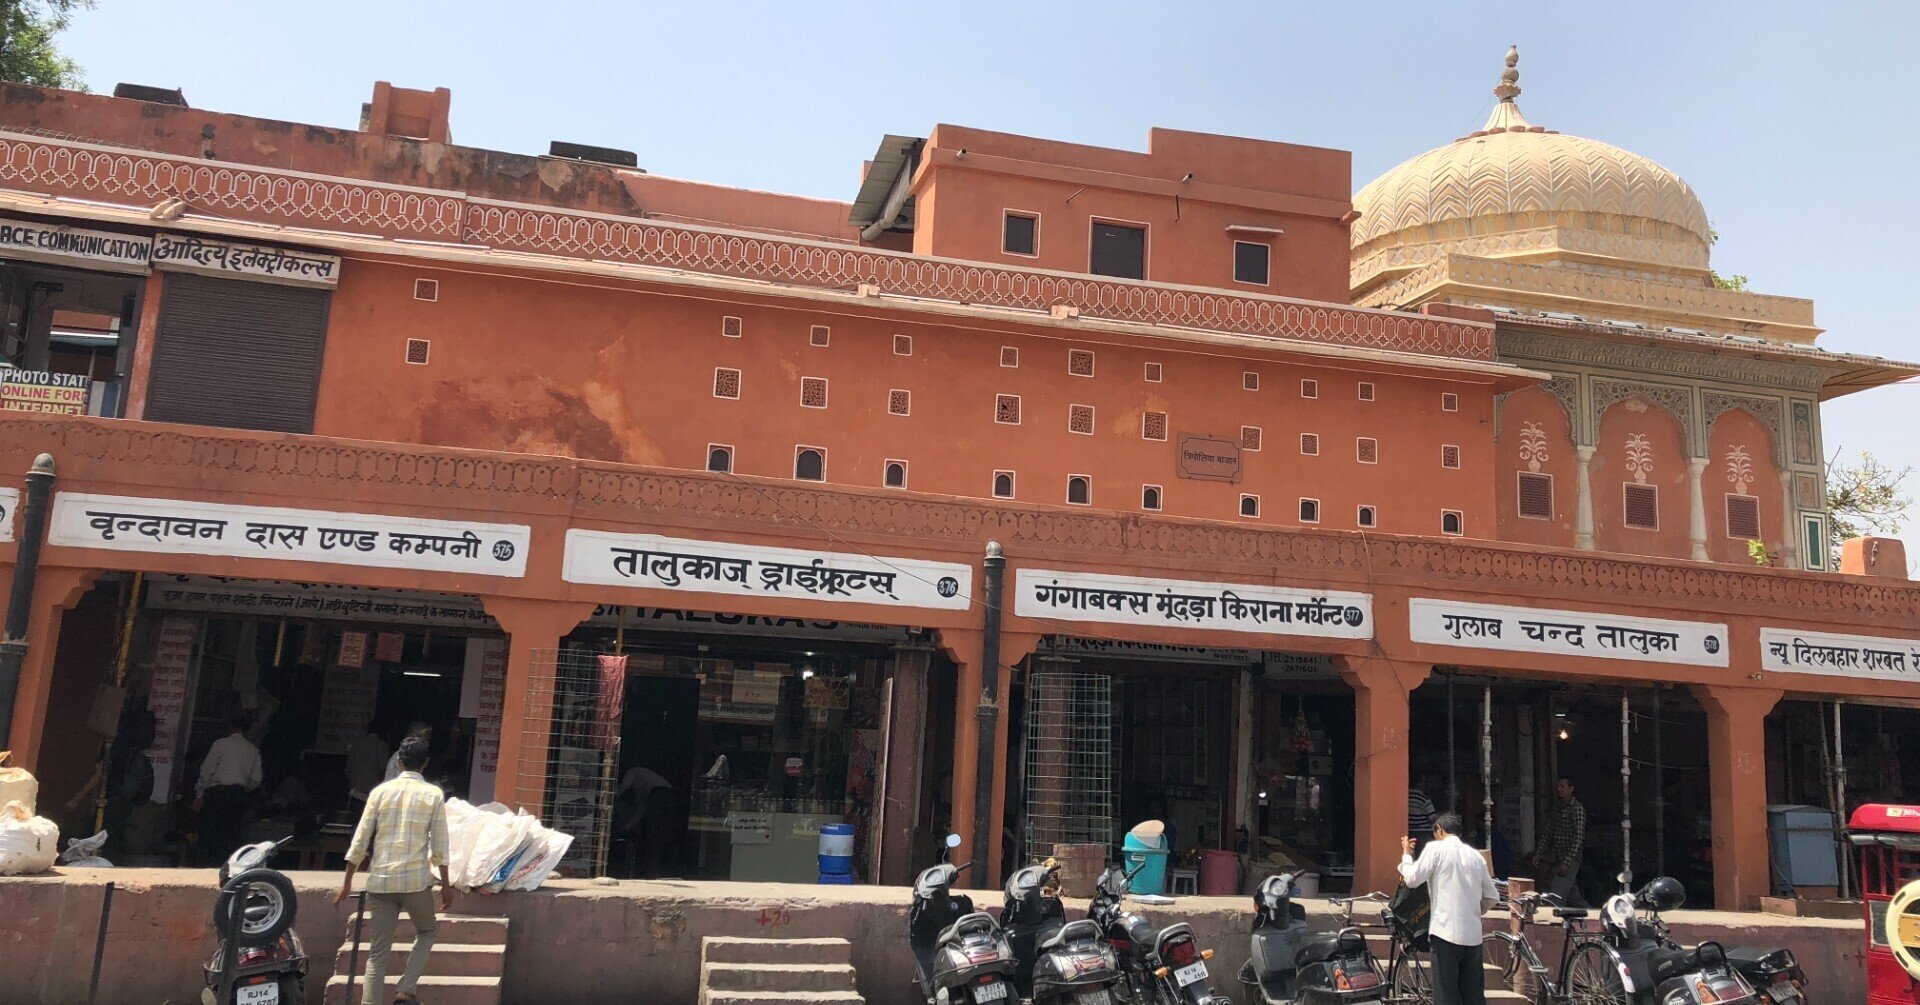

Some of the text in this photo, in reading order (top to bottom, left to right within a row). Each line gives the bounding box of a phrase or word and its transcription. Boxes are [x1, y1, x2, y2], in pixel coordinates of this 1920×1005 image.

[37, 230, 150, 261] COMMUNICATION
[154, 237, 228, 270] आदित्य
[2, 385, 51, 399] ONLINE
[3, 368, 49, 384] PHOTO
[86, 511, 513, 559] वृन्दावन दास एण्ड कम्पनी 375
[611, 547, 752, 590] तालुकाज्
[938, 580, 958, 594] 376
[1035, 580, 1153, 612] गंगाबक्स
[1155, 588, 1217, 622] मूंदड़ा
[1219, 590, 1294, 624] किराना
[1295, 597, 1344, 626] मर्चेन्ट
[1442, 614, 1503, 640] गुलाब
[1519, 621, 1585, 650] चन्द
[1596, 625, 1680, 655] तालुका
[1769, 641, 1790, 667] न्यू
[1792, 638, 1860, 670] दिलबहार
[1862, 648, 1907, 674] शरबत
[247, 989, 269, 999] RJ14
